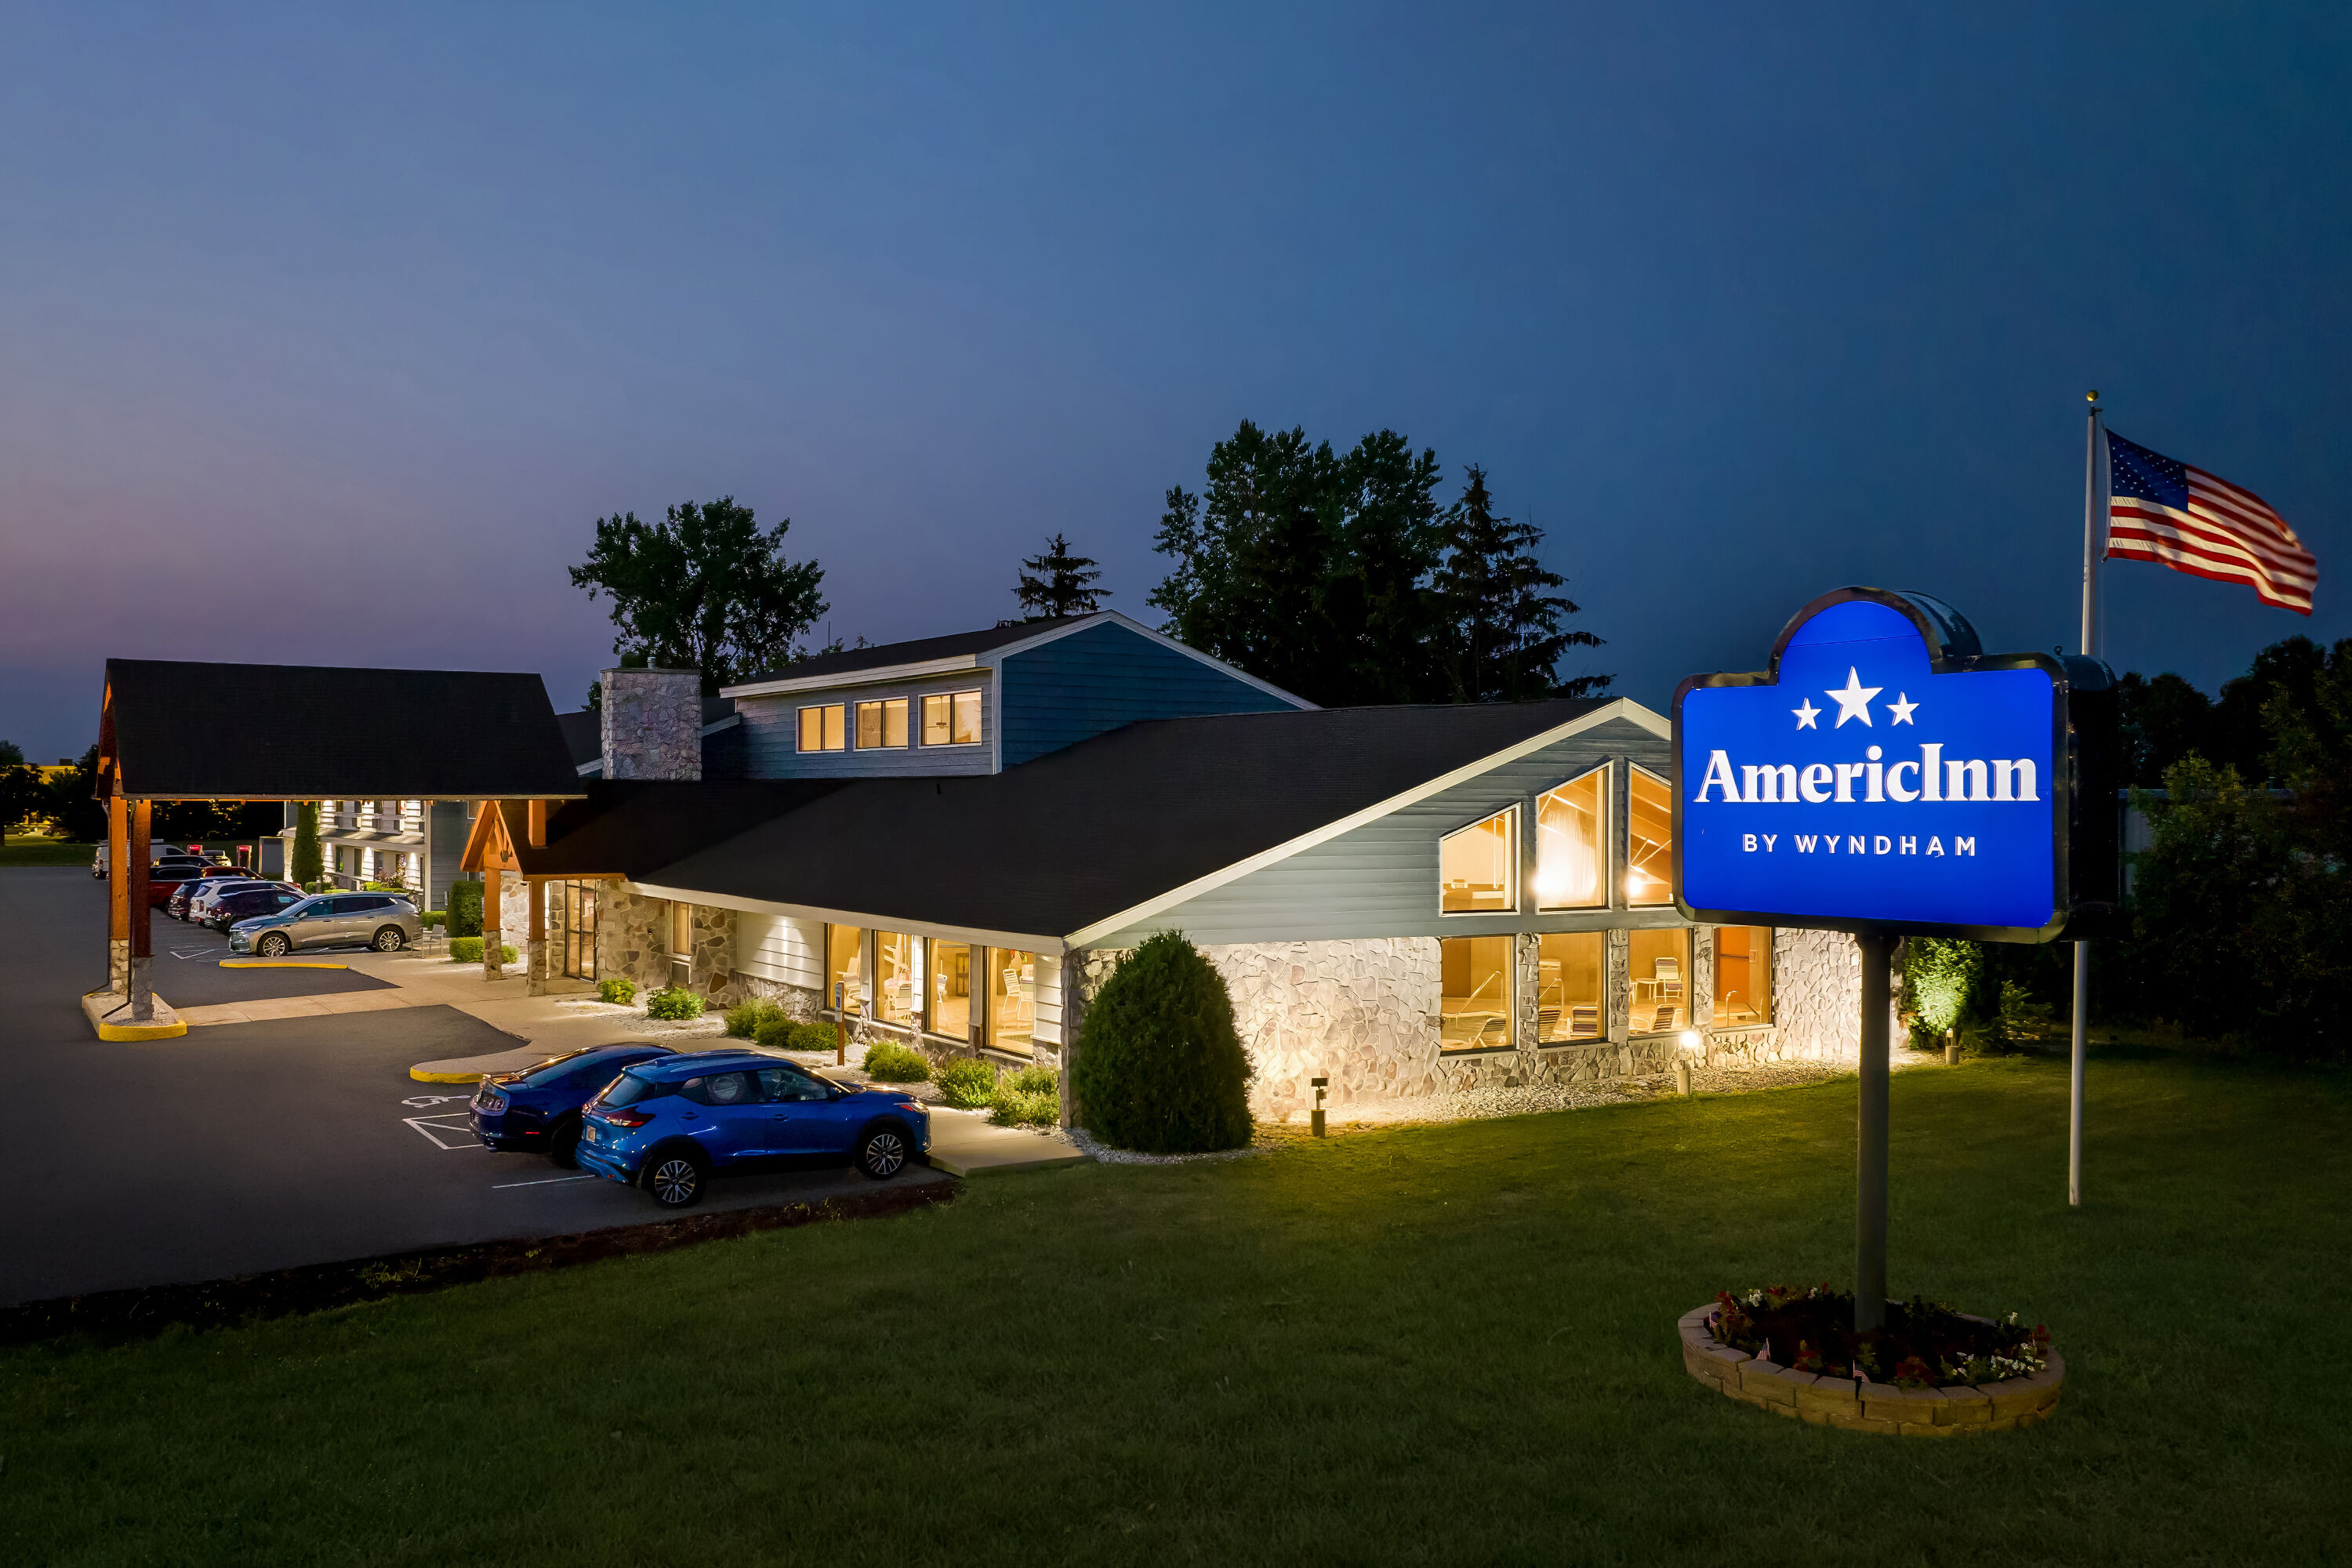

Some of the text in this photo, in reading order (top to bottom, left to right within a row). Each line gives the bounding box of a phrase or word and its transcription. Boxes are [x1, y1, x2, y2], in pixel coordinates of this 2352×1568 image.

[1693, 742, 2041, 803] AmericInn
[1742, 833, 1976, 858] BY WYNDHAM
